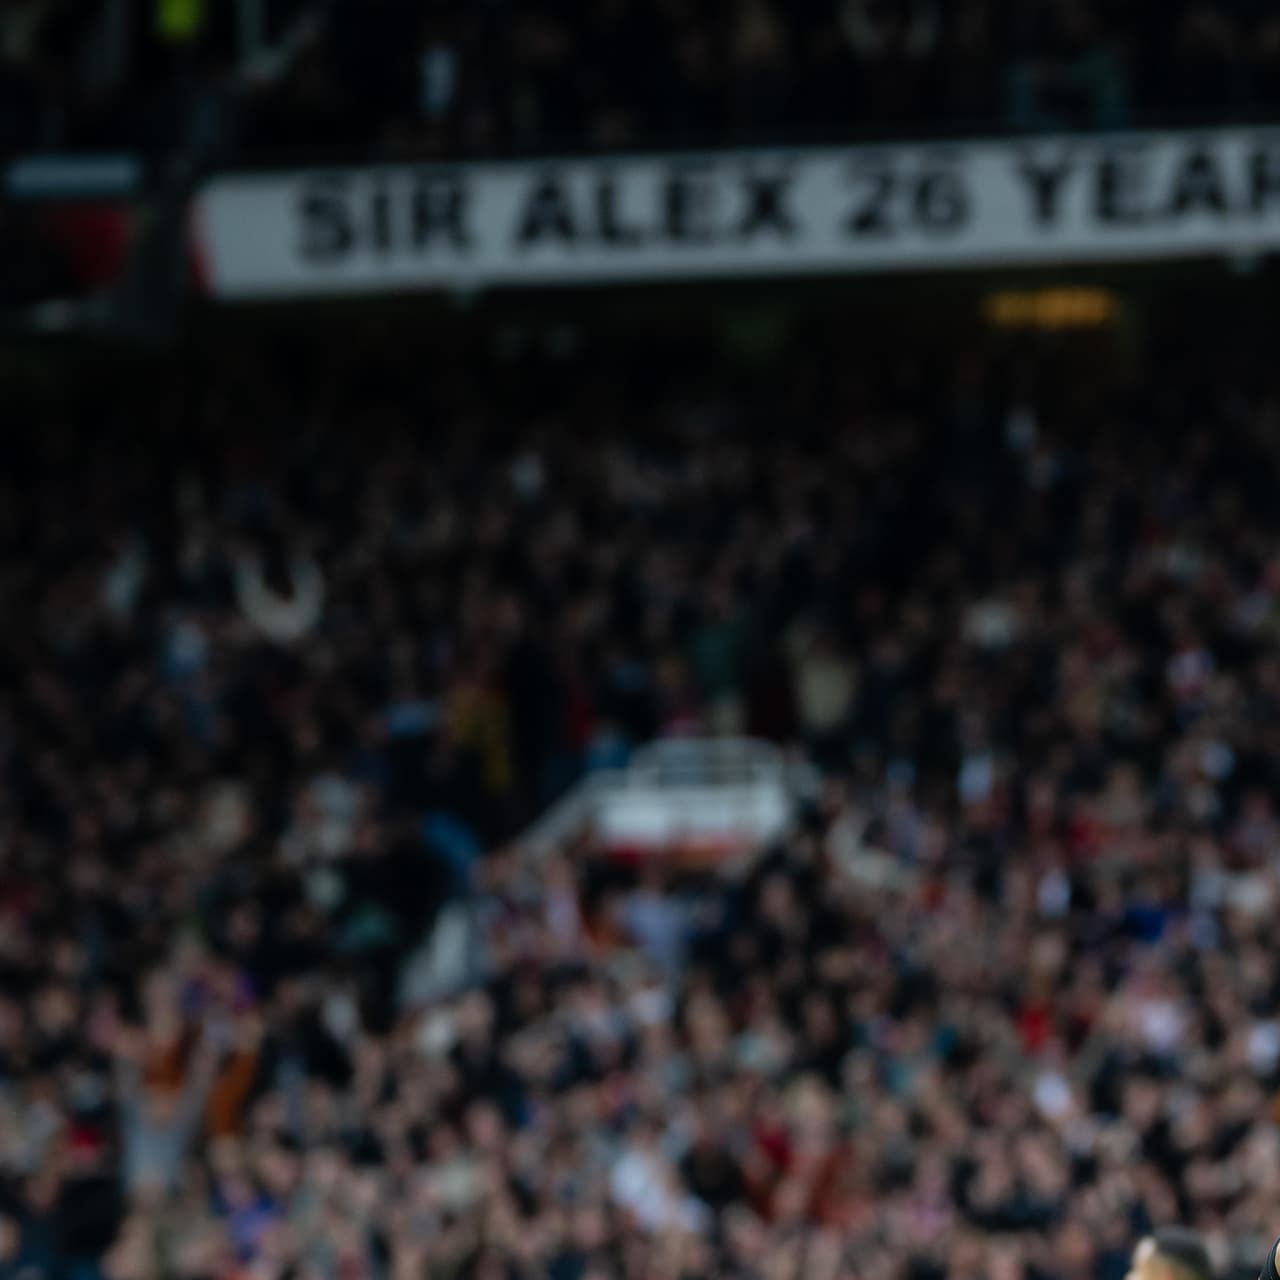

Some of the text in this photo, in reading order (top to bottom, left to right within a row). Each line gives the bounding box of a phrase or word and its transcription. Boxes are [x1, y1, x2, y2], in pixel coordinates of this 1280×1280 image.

[296, 170, 472, 262] SIR
[514, 155, 795, 250] ALEX
[843, 150, 970, 240] 26
